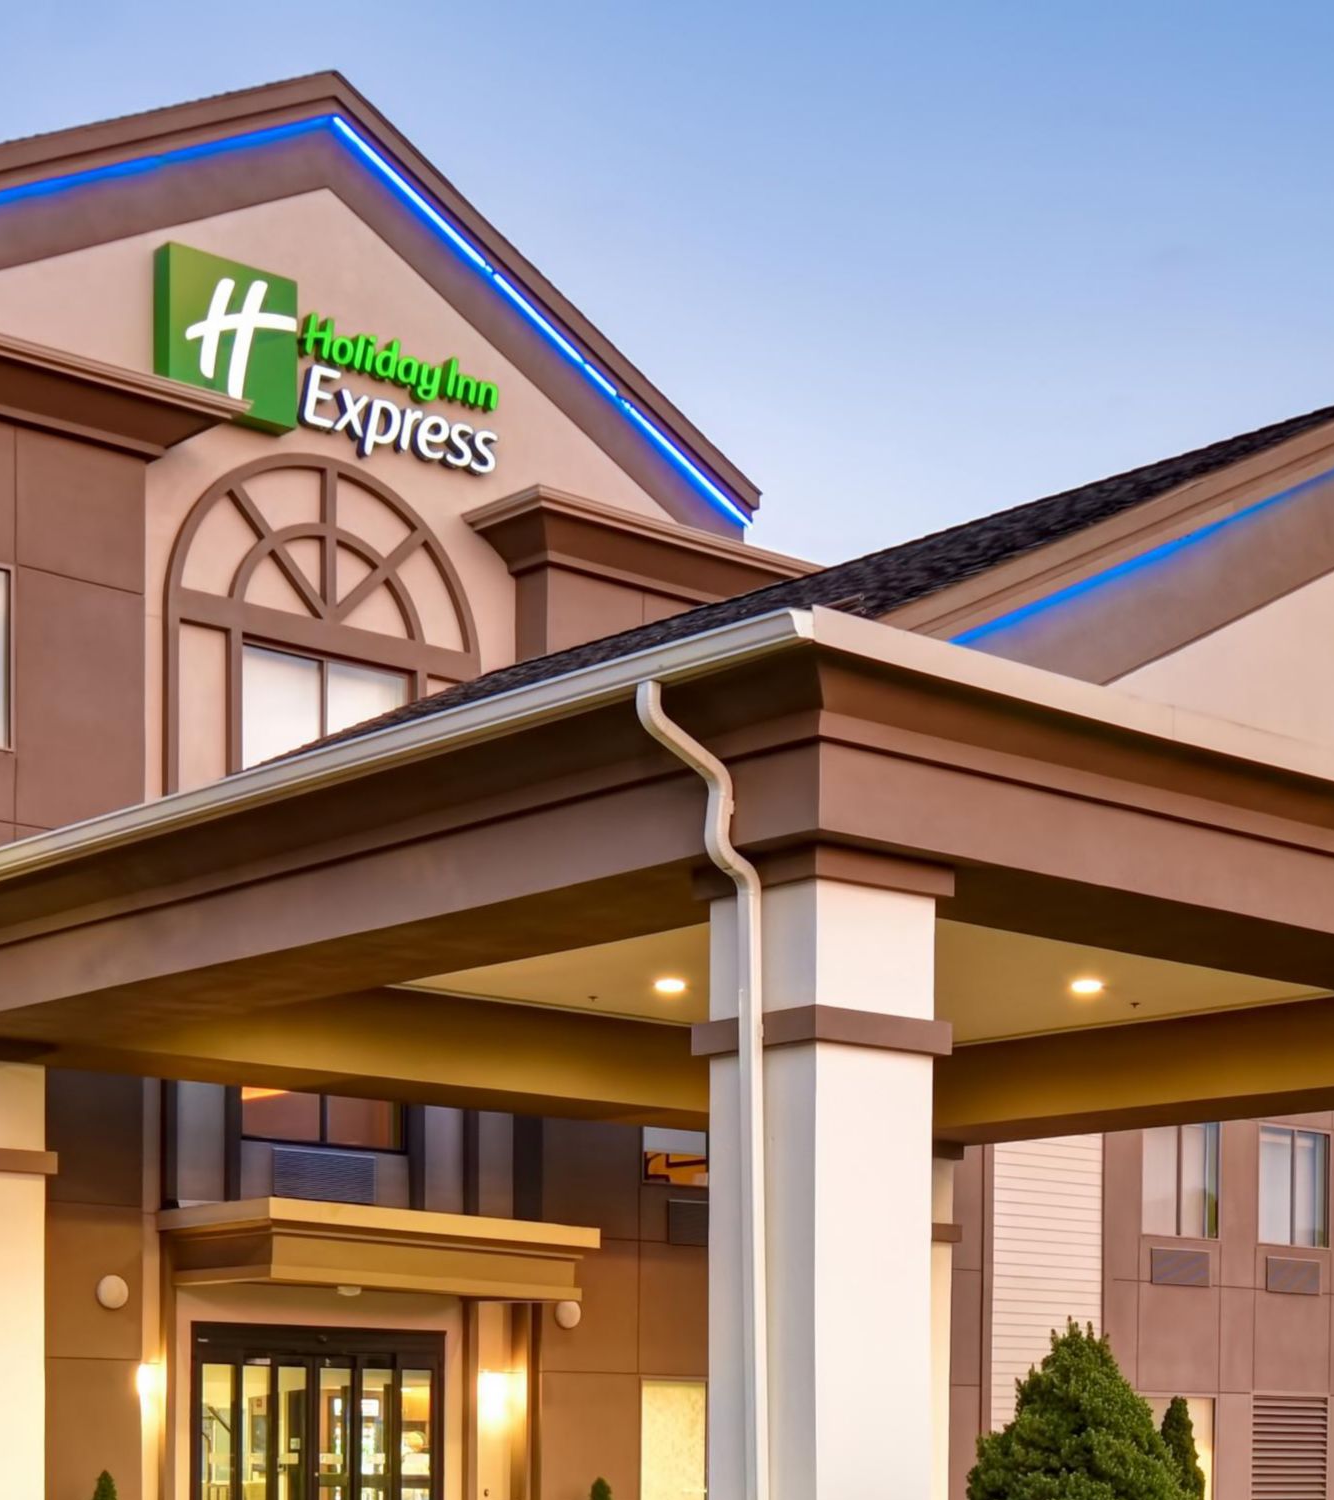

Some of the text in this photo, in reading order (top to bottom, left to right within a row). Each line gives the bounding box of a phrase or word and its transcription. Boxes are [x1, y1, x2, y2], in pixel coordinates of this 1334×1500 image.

[301, 312, 499, 411] Holiday Inn
[300, 364, 499, 475] Express
